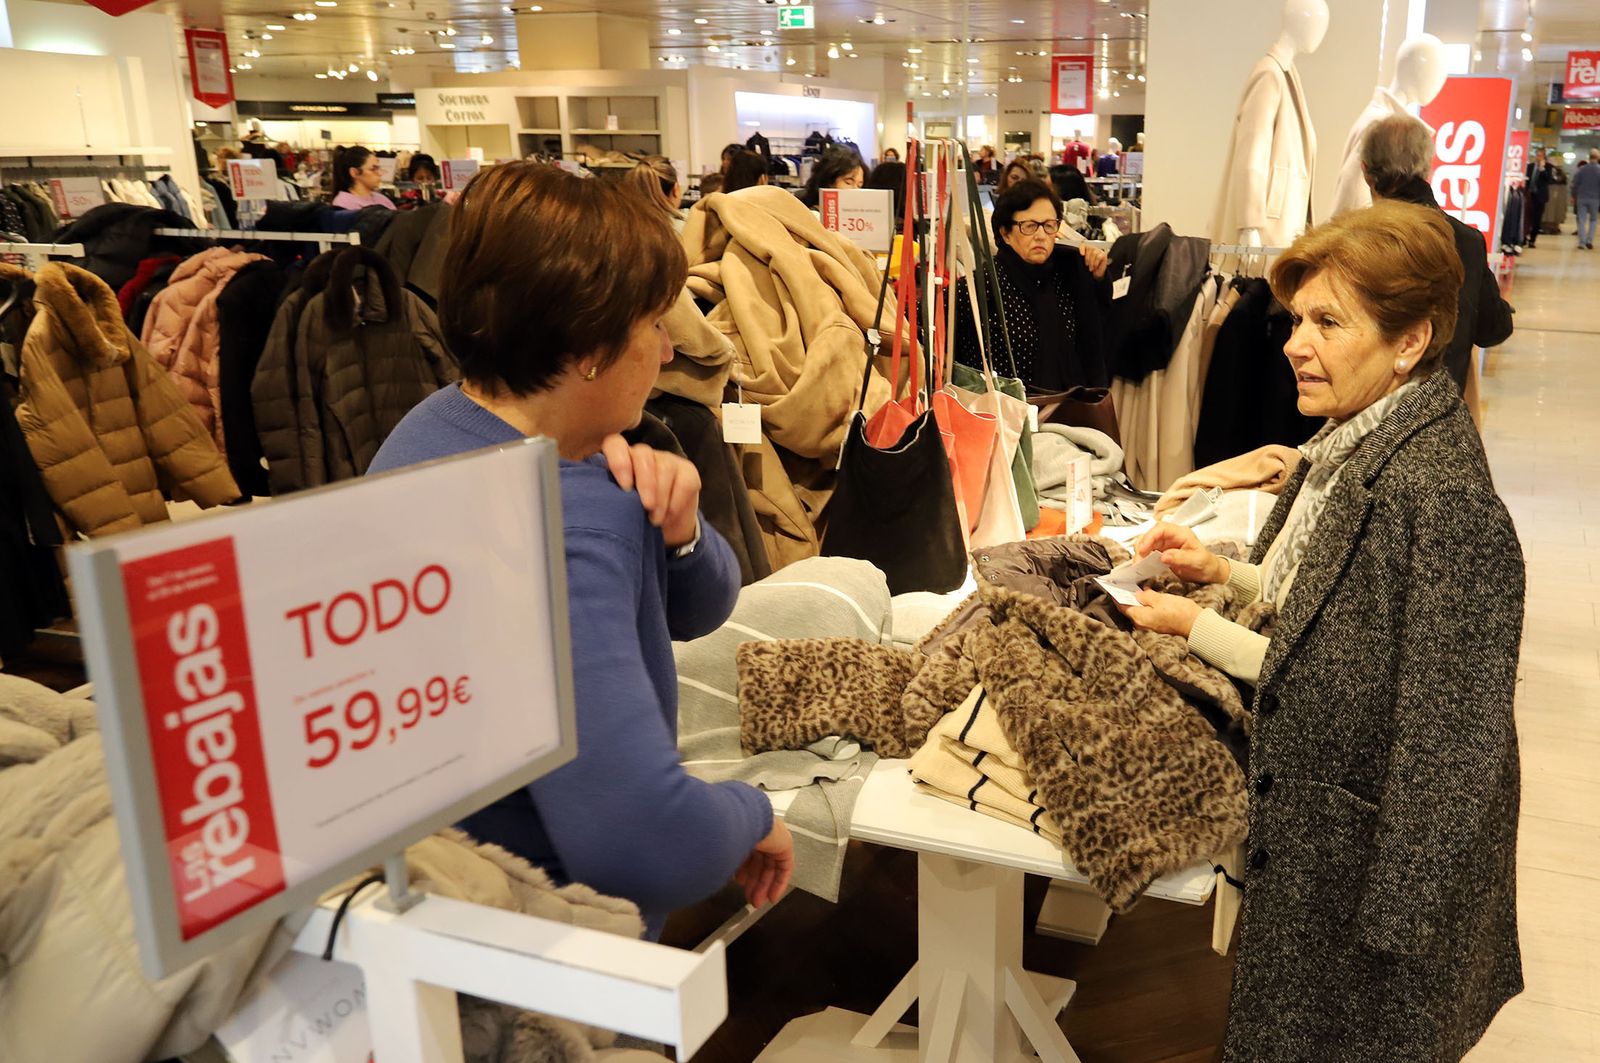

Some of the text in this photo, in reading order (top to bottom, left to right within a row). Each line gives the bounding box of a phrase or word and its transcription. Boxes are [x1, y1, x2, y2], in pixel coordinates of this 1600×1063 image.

[1568, 59, 1600, 84] re
[842, 217, 874, 232] -30%
[285, 563, 453, 659] TODO
[164, 602, 255, 887] rebajas
[302, 674, 473, 769] 59,99€
[180, 841, 214, 902] Las
